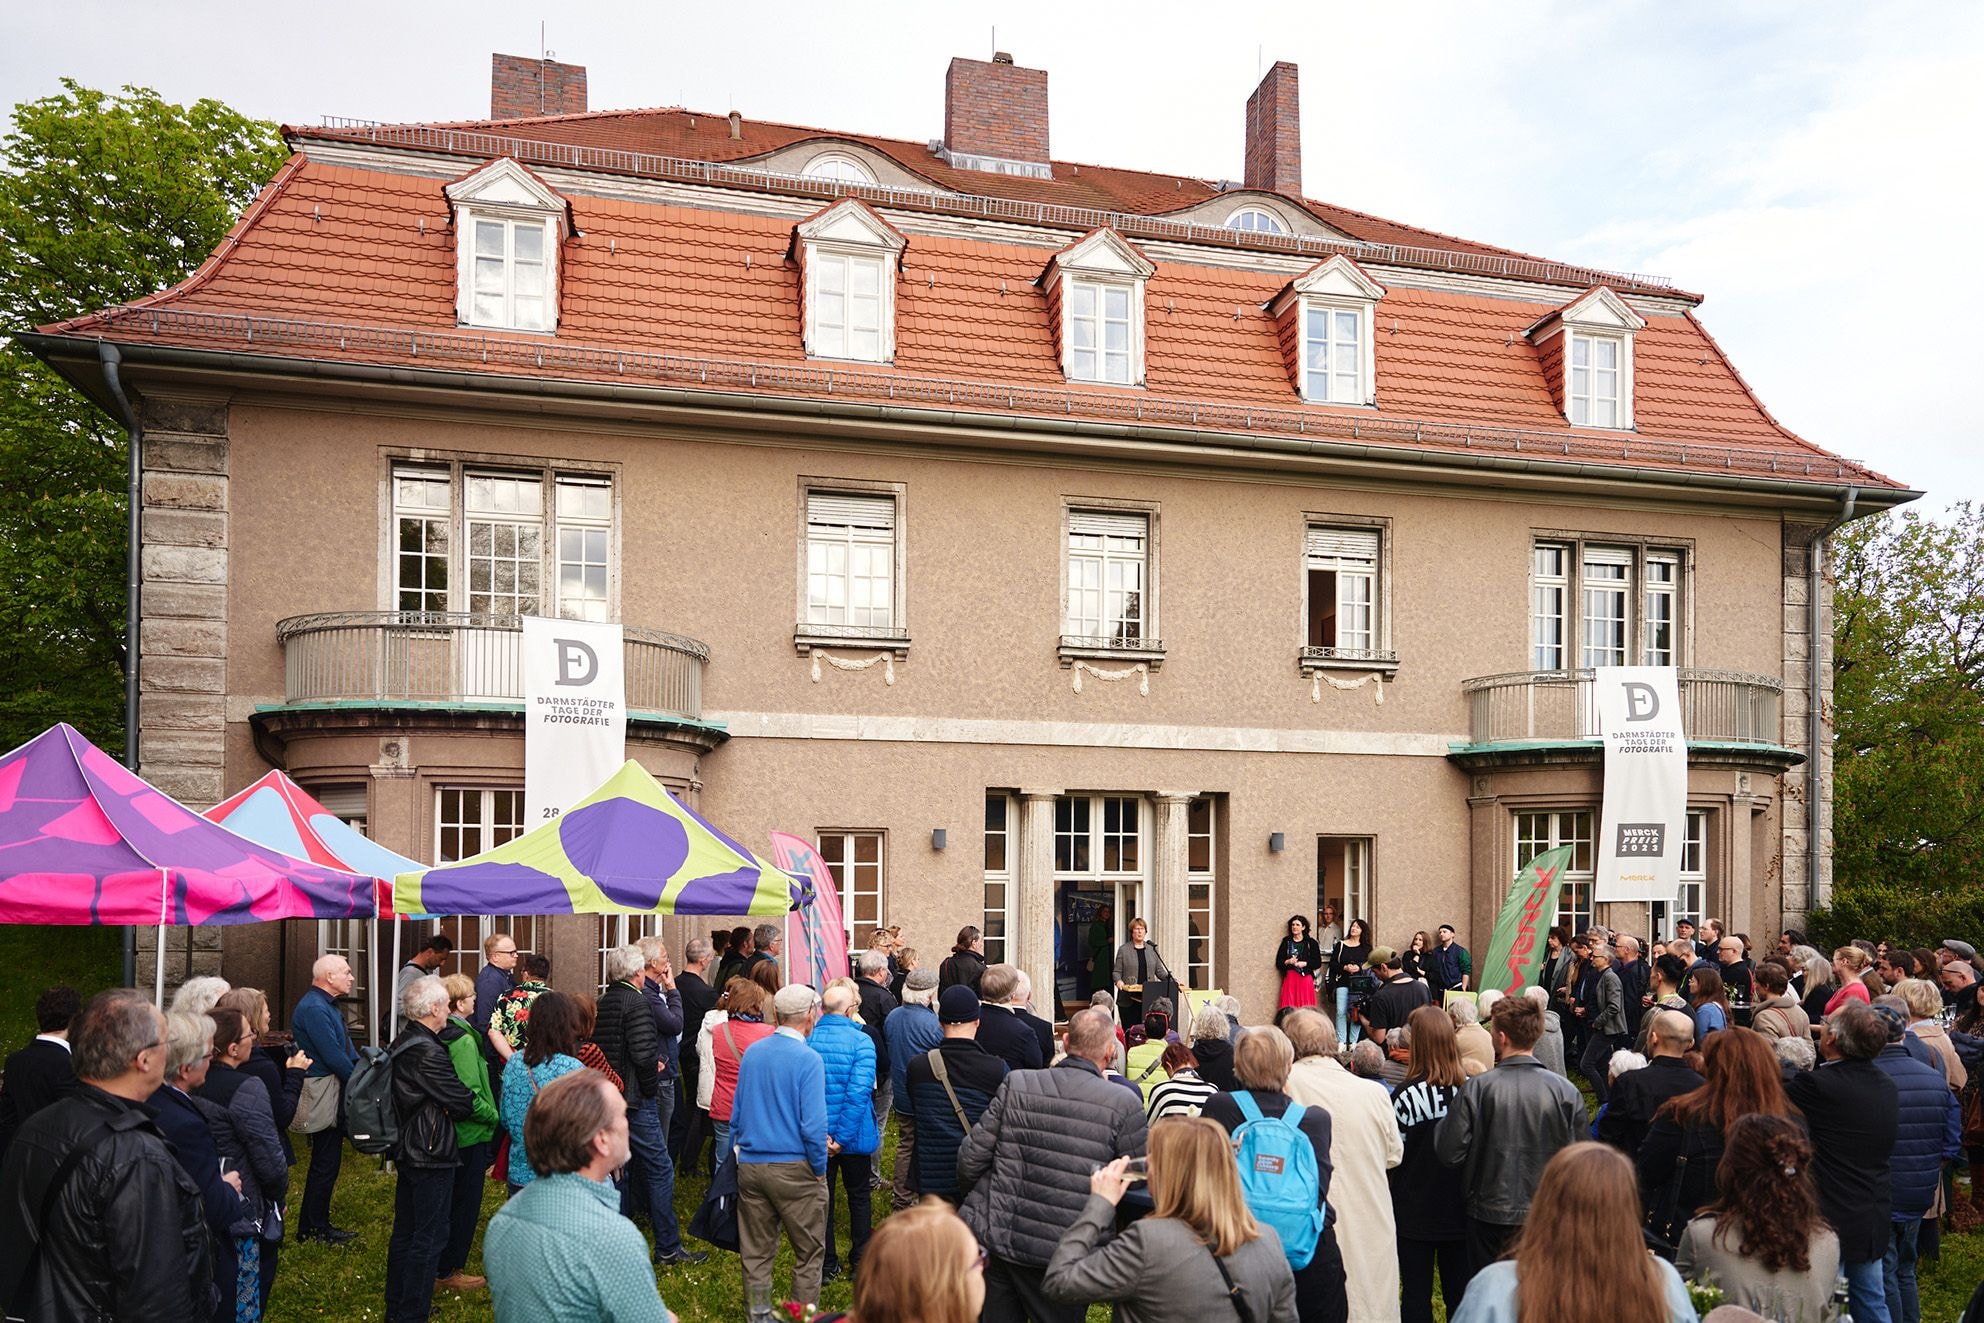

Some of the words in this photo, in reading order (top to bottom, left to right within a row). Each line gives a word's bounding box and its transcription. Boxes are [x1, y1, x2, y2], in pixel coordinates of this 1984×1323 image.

[537, 696, 615, 709] DARMSTÄDTER
[551, 706, 579, 715] TAGE
[582, 708, 603, 716] DER
[543, 714, 610, 727] FOTOGRAFIE
[1612, 730, 1676, 739] DARMSTÄDTER
[1619, 746, 1673, 754] FOTOGRAFIE
[542, 807, 560, 819] 28
[1622, 828, 1660, 837] MERCK
[1622, 836, 1659, 844] PREIS
[1621, 844, 1658, 852] 2023
